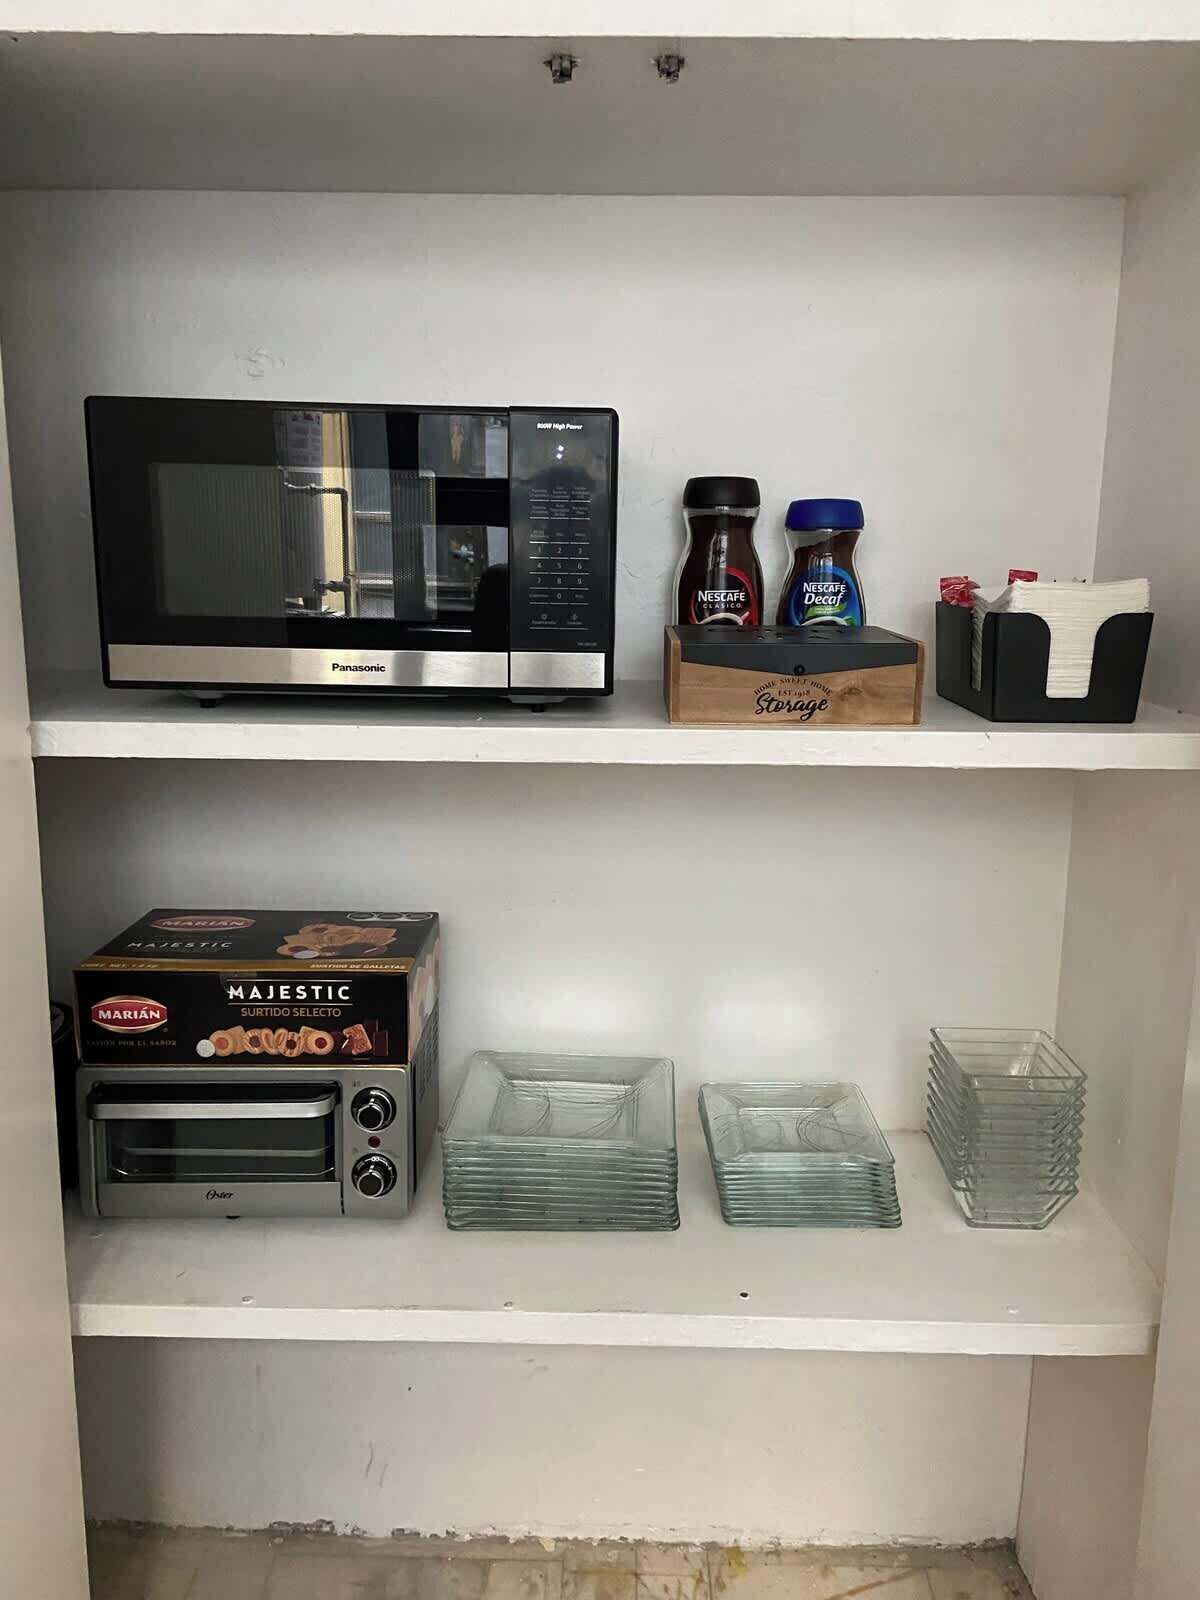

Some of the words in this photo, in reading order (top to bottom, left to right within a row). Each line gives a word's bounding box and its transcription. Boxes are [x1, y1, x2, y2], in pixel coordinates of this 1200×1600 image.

[553, 423, 565, 431] High
[556, 592, 562, 600] 0
[804, 593, 844, 607] Decaf
[331, 663, 386, 672] Panasonic
[753, 680, 777, 695] HOME
[810, 681, 833, 697] HOME
[754, 692, 829, 721] Storage
[228, 985, 350, 1000] MAJESTIC
[98, 1006, 160, 1020] MARIÁN
[241, 1007, 290, 1018] SURTIDO
[292, 1007, 342, 1018] SELECTO
[206, 1188, 234, 1200] Oster
